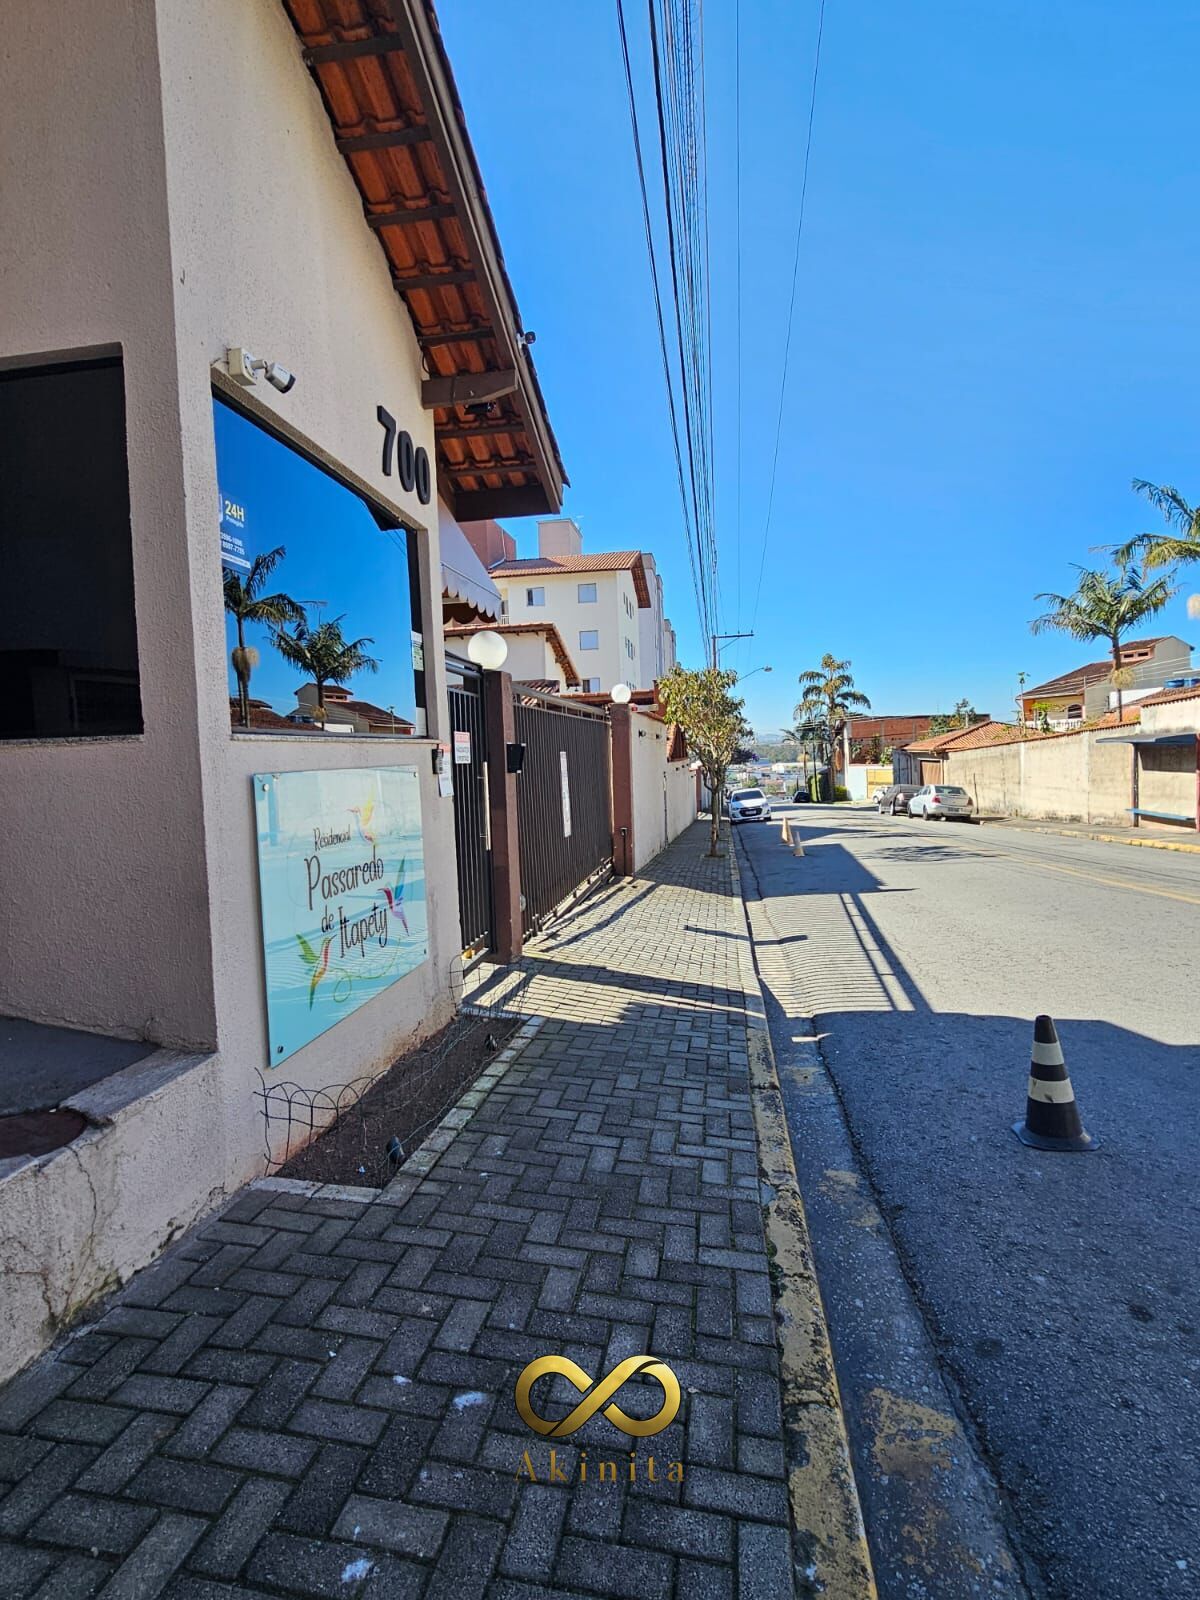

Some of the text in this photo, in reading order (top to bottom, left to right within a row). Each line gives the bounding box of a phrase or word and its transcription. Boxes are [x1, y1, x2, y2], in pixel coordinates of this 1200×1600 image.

[376, 405, 431, 505] 700
[224, 500, 245, 522] 24H
[313, 824, 351, 851] Residencial
[304, 845, 384, 911] Passaredo
[321, 902, 388, 958] de Itapety
